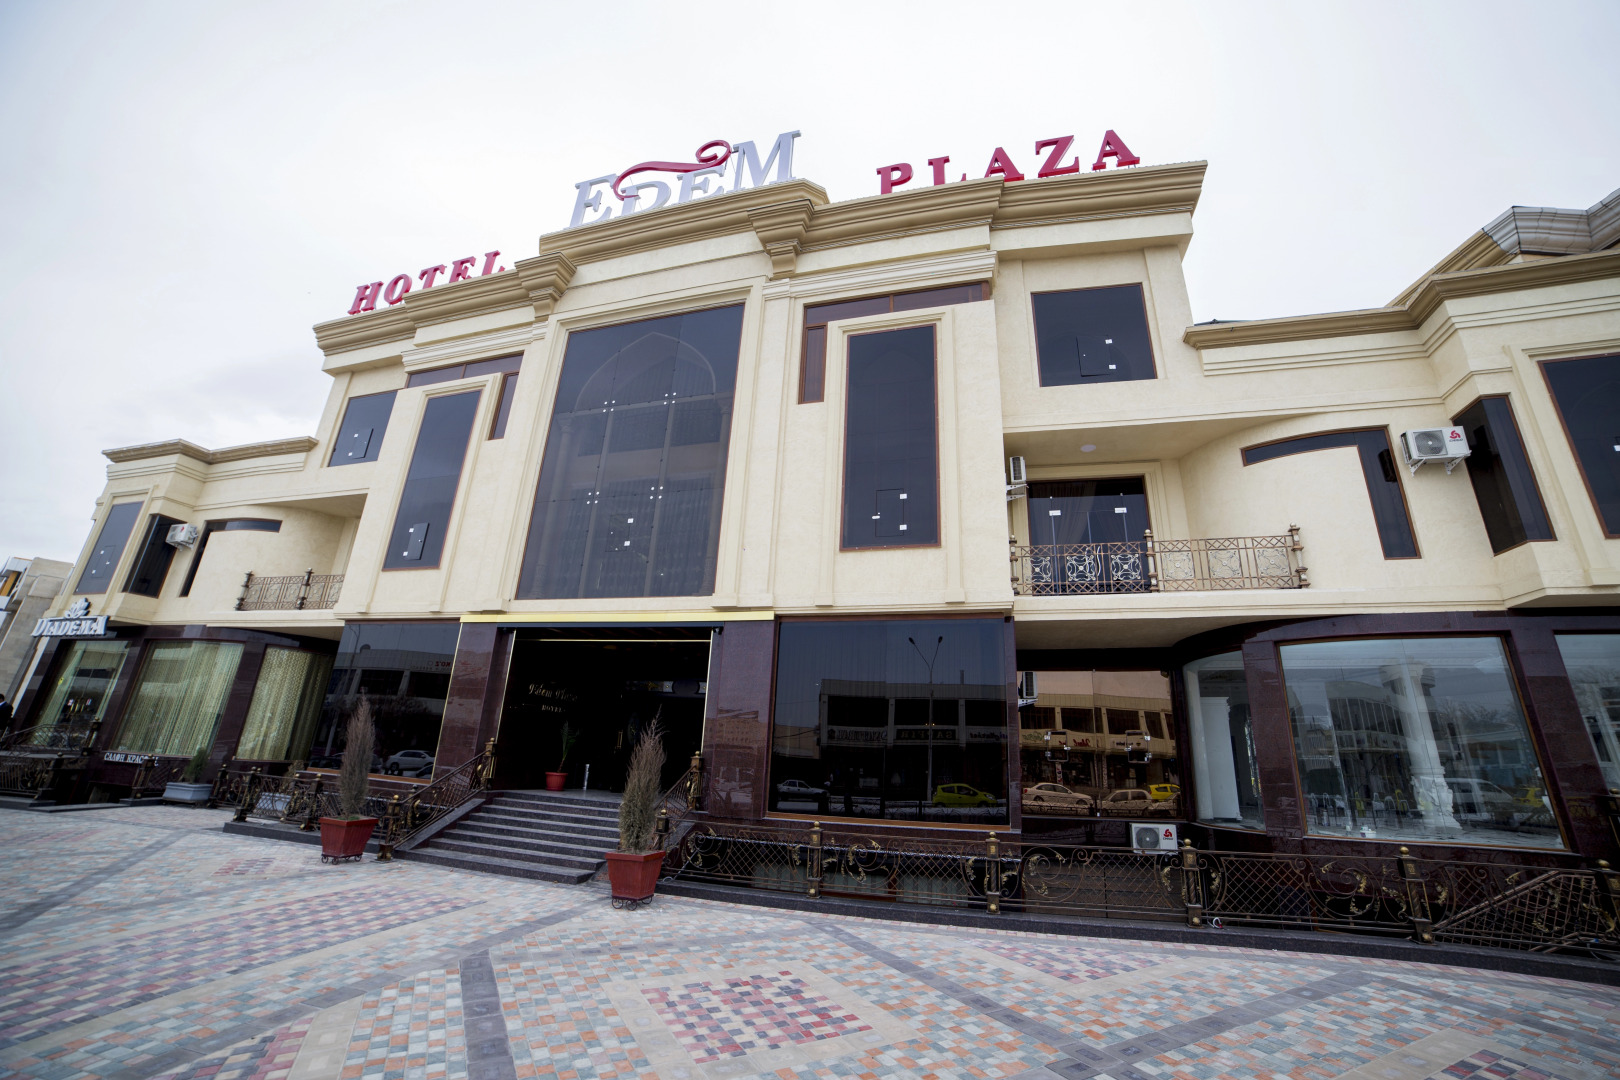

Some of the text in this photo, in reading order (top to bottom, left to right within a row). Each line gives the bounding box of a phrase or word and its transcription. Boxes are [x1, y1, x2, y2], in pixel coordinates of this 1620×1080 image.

[347, 129, 1141, 315] HOTEL EDEM PLAZA
[31, 615, 109, 636] DIADEMA
[104, 752, 126, 762] САЛОН
